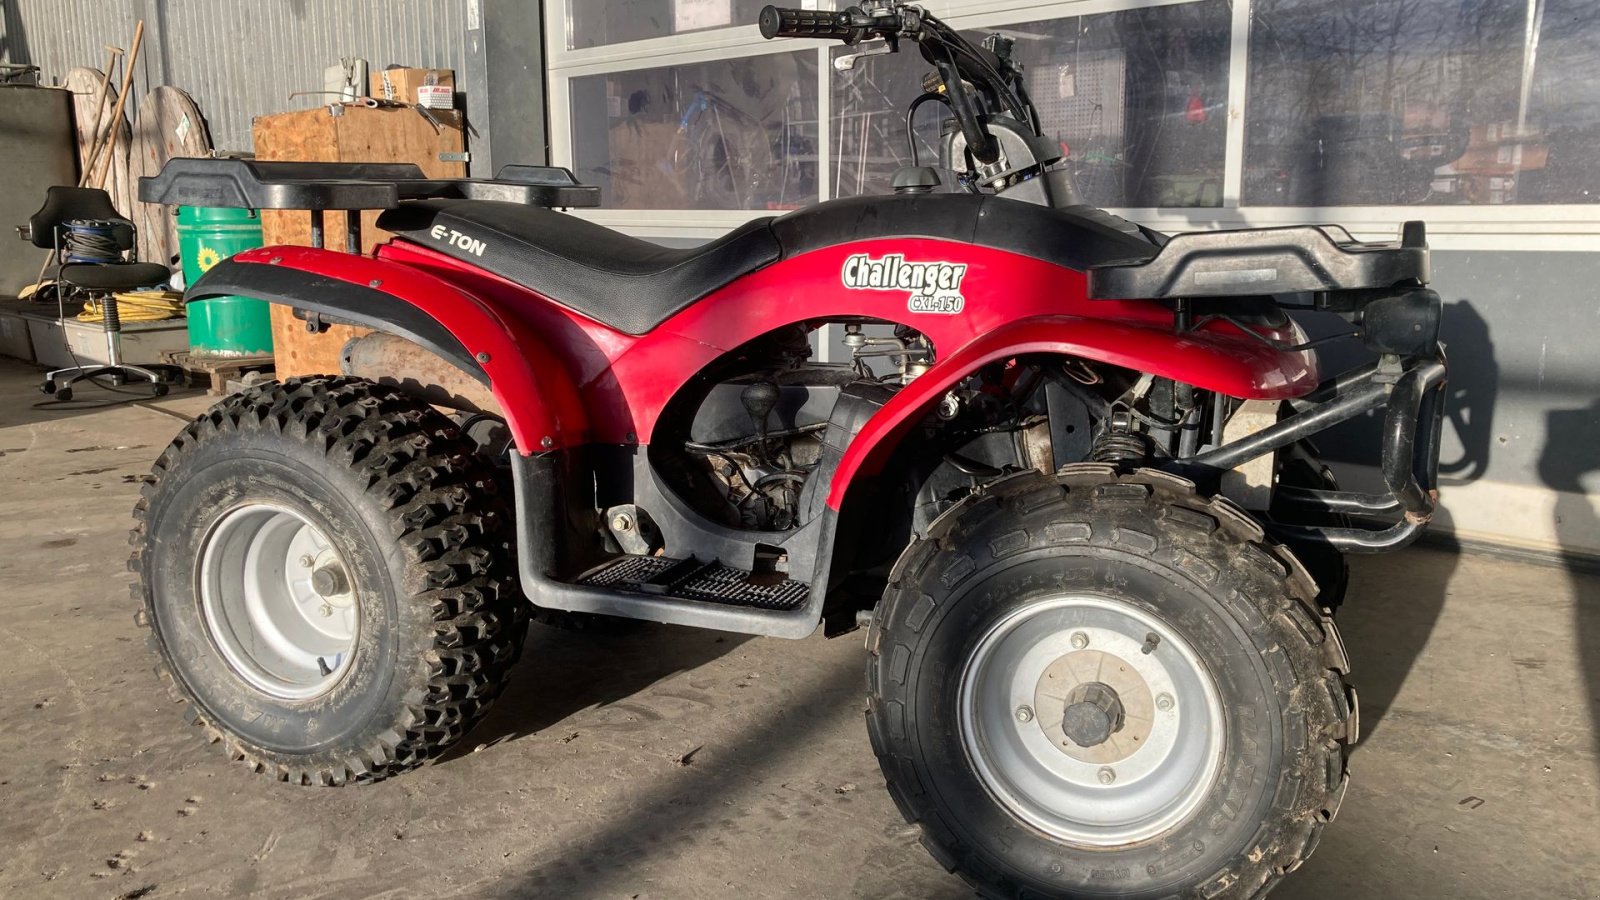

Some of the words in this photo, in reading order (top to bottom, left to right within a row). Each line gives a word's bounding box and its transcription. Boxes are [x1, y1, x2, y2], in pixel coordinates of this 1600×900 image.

[431, 224, 487, 257] E-TON
[844, 254, 966, 296] Challenger
[910, 295, 963, 313] CXL-150
